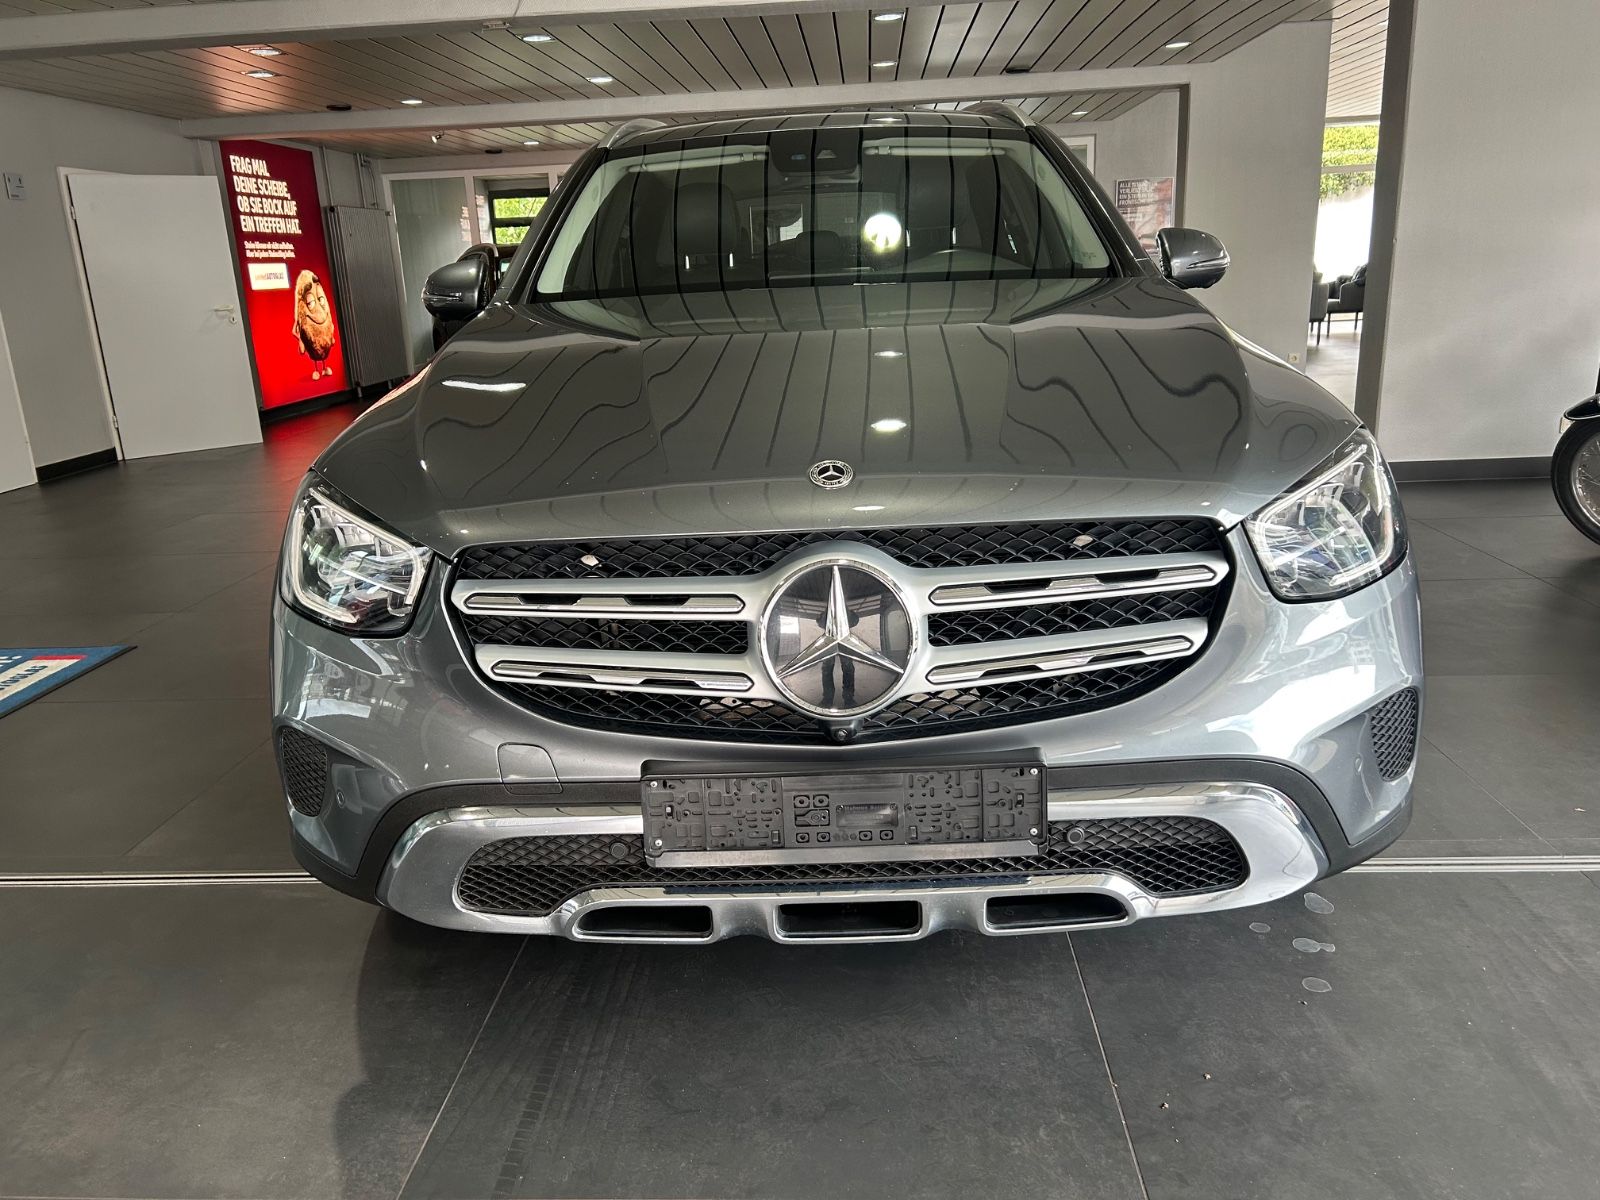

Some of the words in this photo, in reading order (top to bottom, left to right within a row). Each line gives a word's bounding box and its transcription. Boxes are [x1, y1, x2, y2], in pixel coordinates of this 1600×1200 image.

[229, 154, 252, 174] FRAG
[251, 158, 271, 177] MAL
[233, 175, 258, 194] DEINE
[257, 178, 291, 200] SCHEIBE,
[237, 195, 251, 213] OB
[249, 196, 264, 214] SIE
[261, 197, 284, 215] BOCK
[283, 200, 297, 216] AUF
[240, 214, 256, 232] EIN
[253, 216, 287, 234] TREFFEN
[285, 218, 302, 234] HAT.
